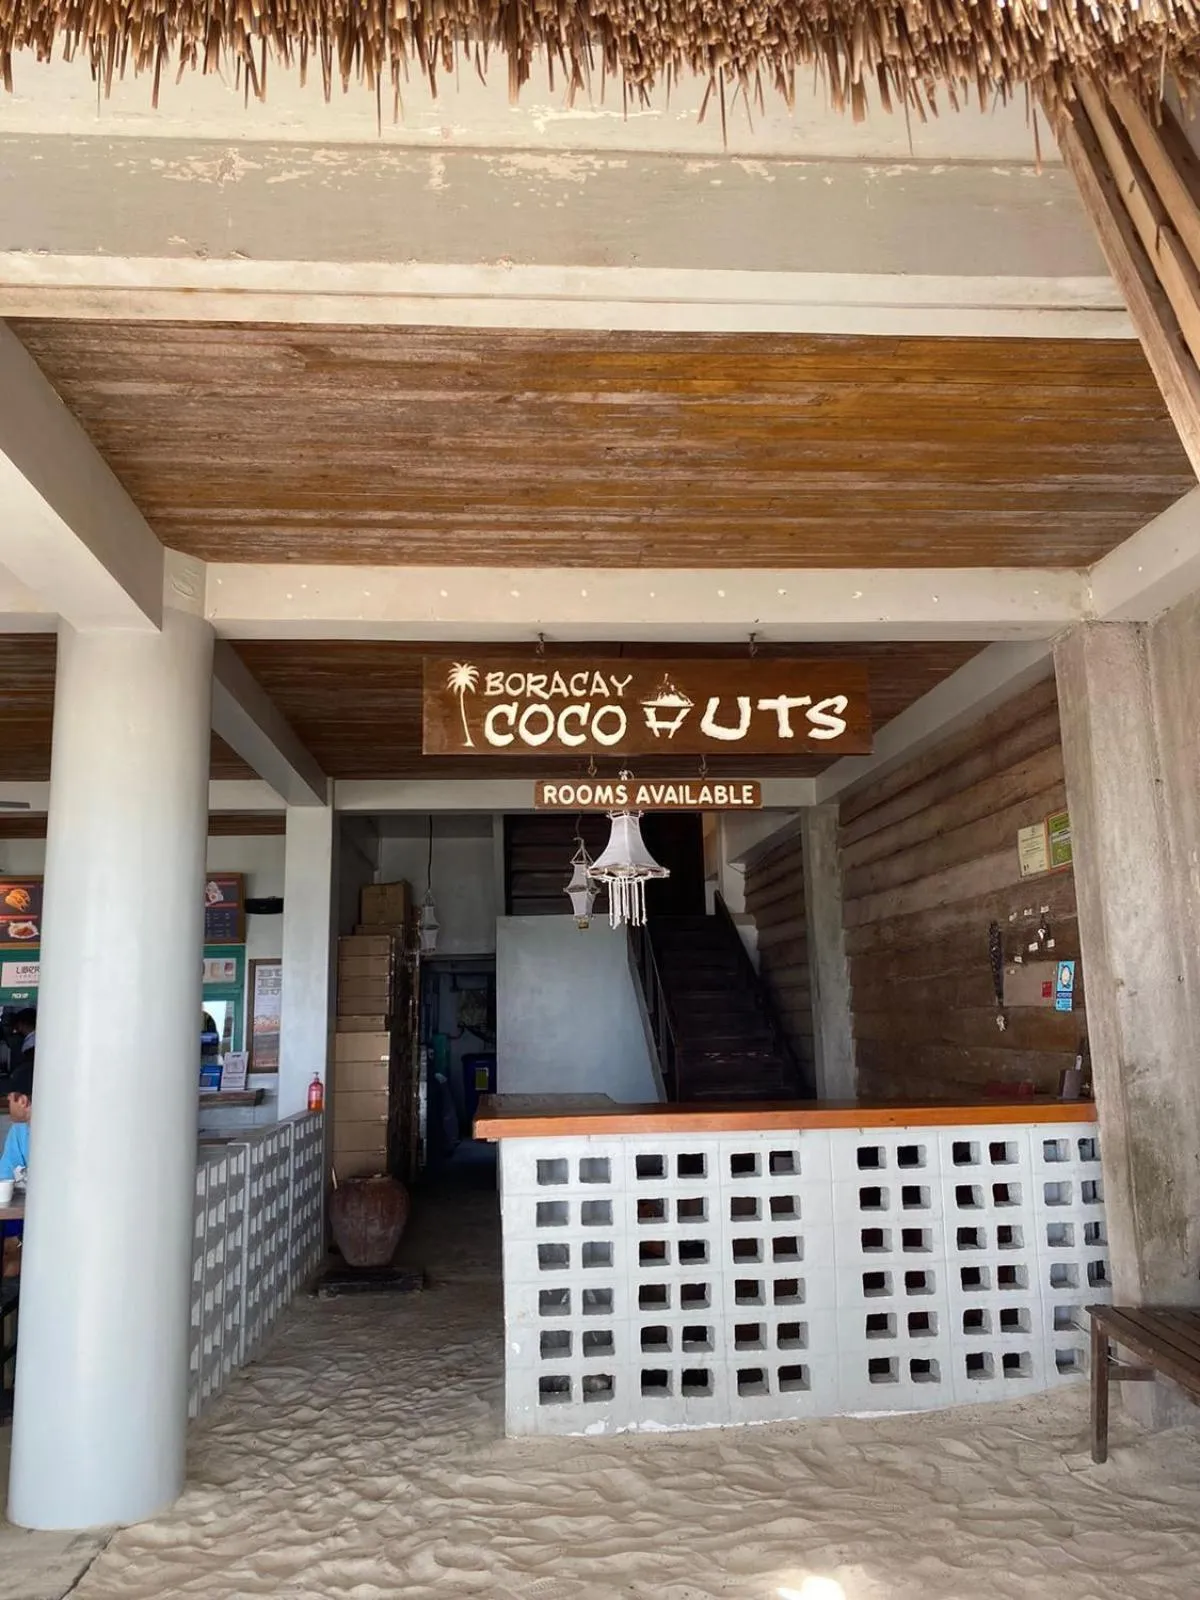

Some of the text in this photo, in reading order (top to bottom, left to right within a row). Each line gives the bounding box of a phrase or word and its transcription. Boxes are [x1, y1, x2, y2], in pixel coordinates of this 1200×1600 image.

[484, 671, 632, 700] BORACAY
[484, 702, 627, 746] COCO
[543, 784, 754, 805] ROOMS AVAILABLE
